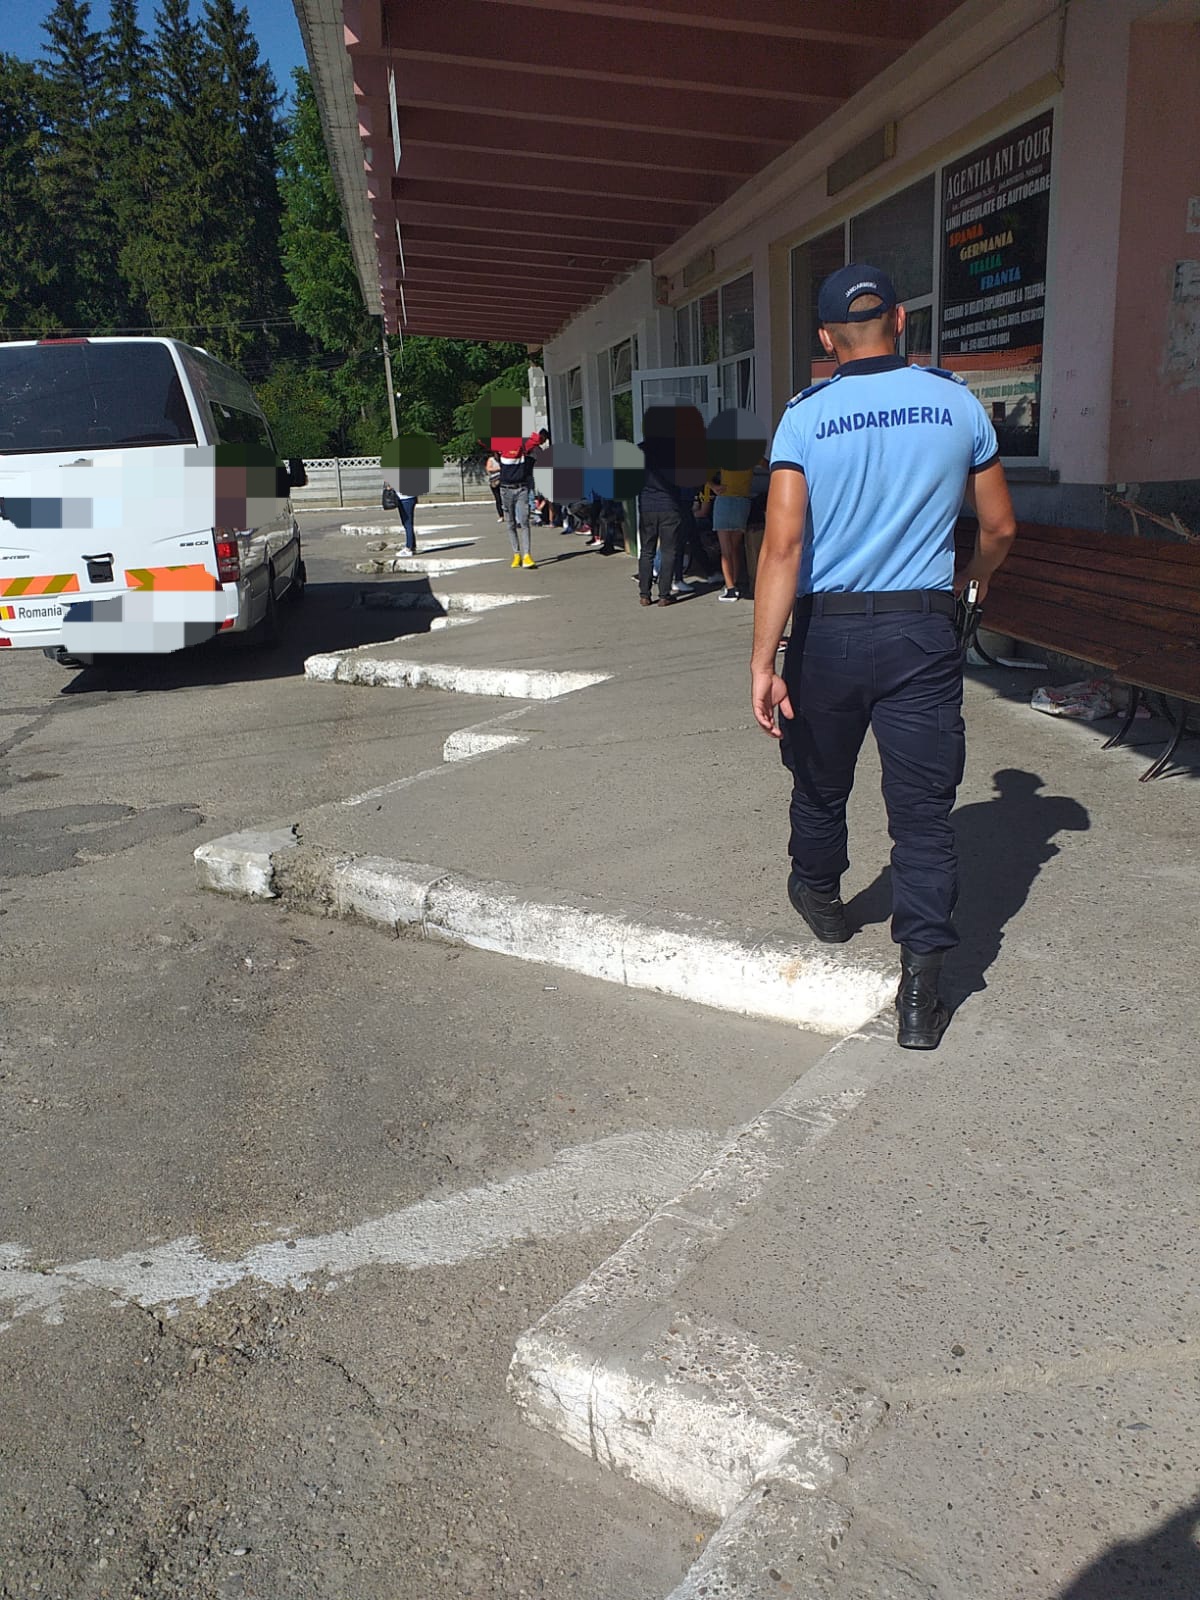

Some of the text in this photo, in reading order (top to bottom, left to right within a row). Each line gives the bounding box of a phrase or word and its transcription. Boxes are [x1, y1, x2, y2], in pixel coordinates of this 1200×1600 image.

[947, 157, 991, 200] AGENTIA
[993, 144, 1014, 179] ANI
[1017, 126, 1051, 168] TOUR
[961, 198, 995, 225] REGULATE
[996, 193, 1007, 210] DE
[1007, 174, 1050, 206] AUTOCARE
[960, 230, 1014, 261] GERMANIA
[969, 253, 1002, 276] ITALIA
[816, 406, 953, 440] JANDARMERIA
[18, 604, 62, 619] Romania
